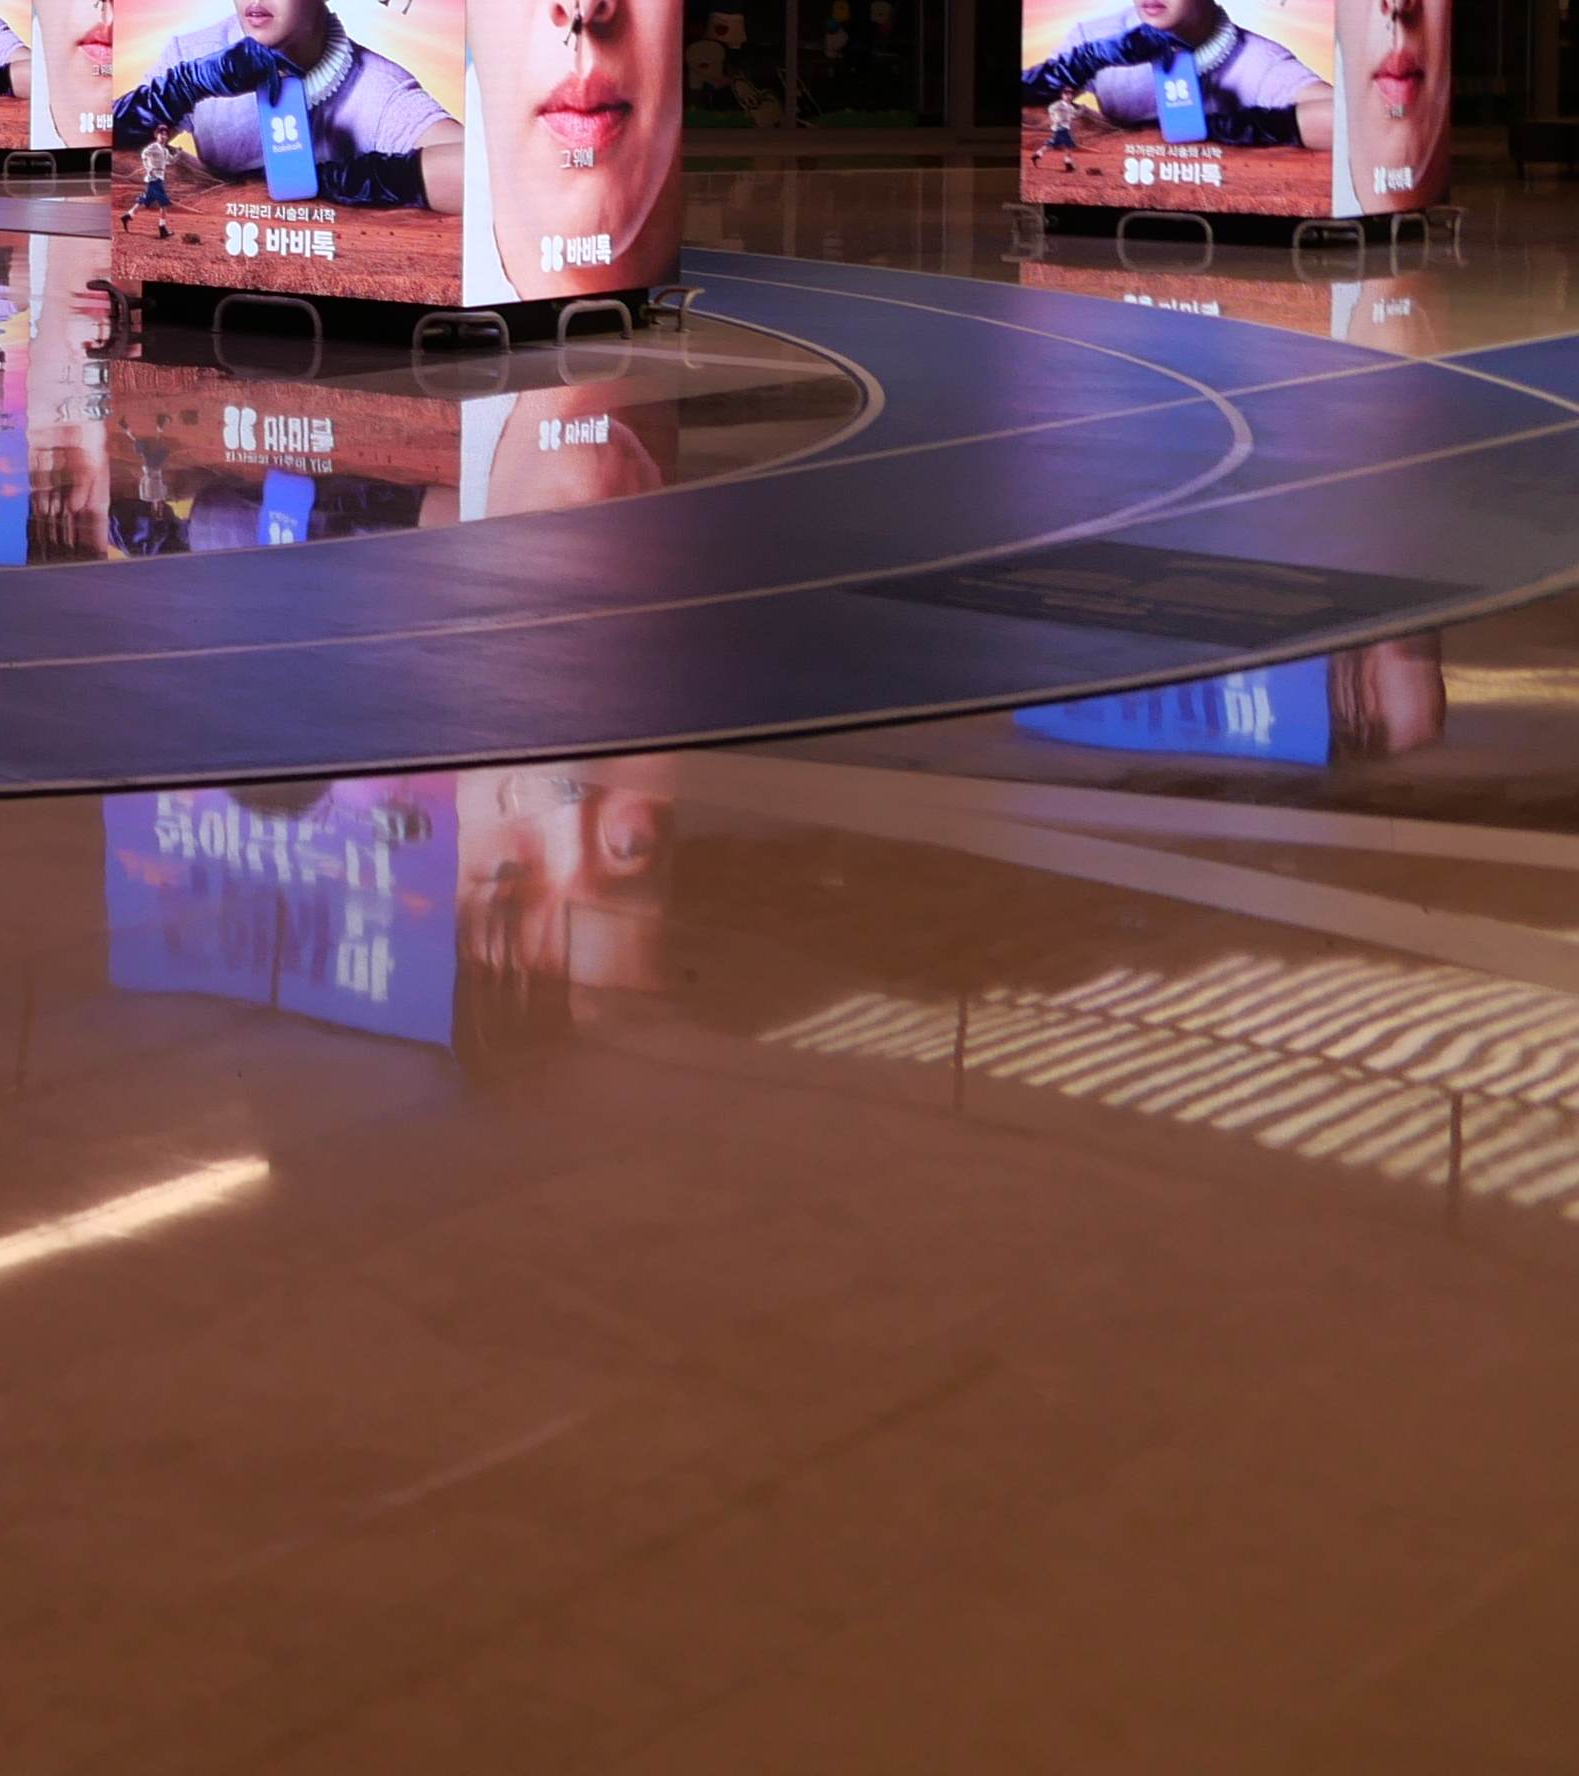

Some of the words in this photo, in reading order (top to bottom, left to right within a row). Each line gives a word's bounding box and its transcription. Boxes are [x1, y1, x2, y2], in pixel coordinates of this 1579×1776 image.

[1159, 161, 1223, 187] 바비톡
[226, 203, 271, 220] 자기관리
[275, 205, 309, 222] 시술의
[312, 208, 337, 224] 시작
[266, 227, 336, 261] 바비톡
[566, 233, 612, 266] 바비톡
